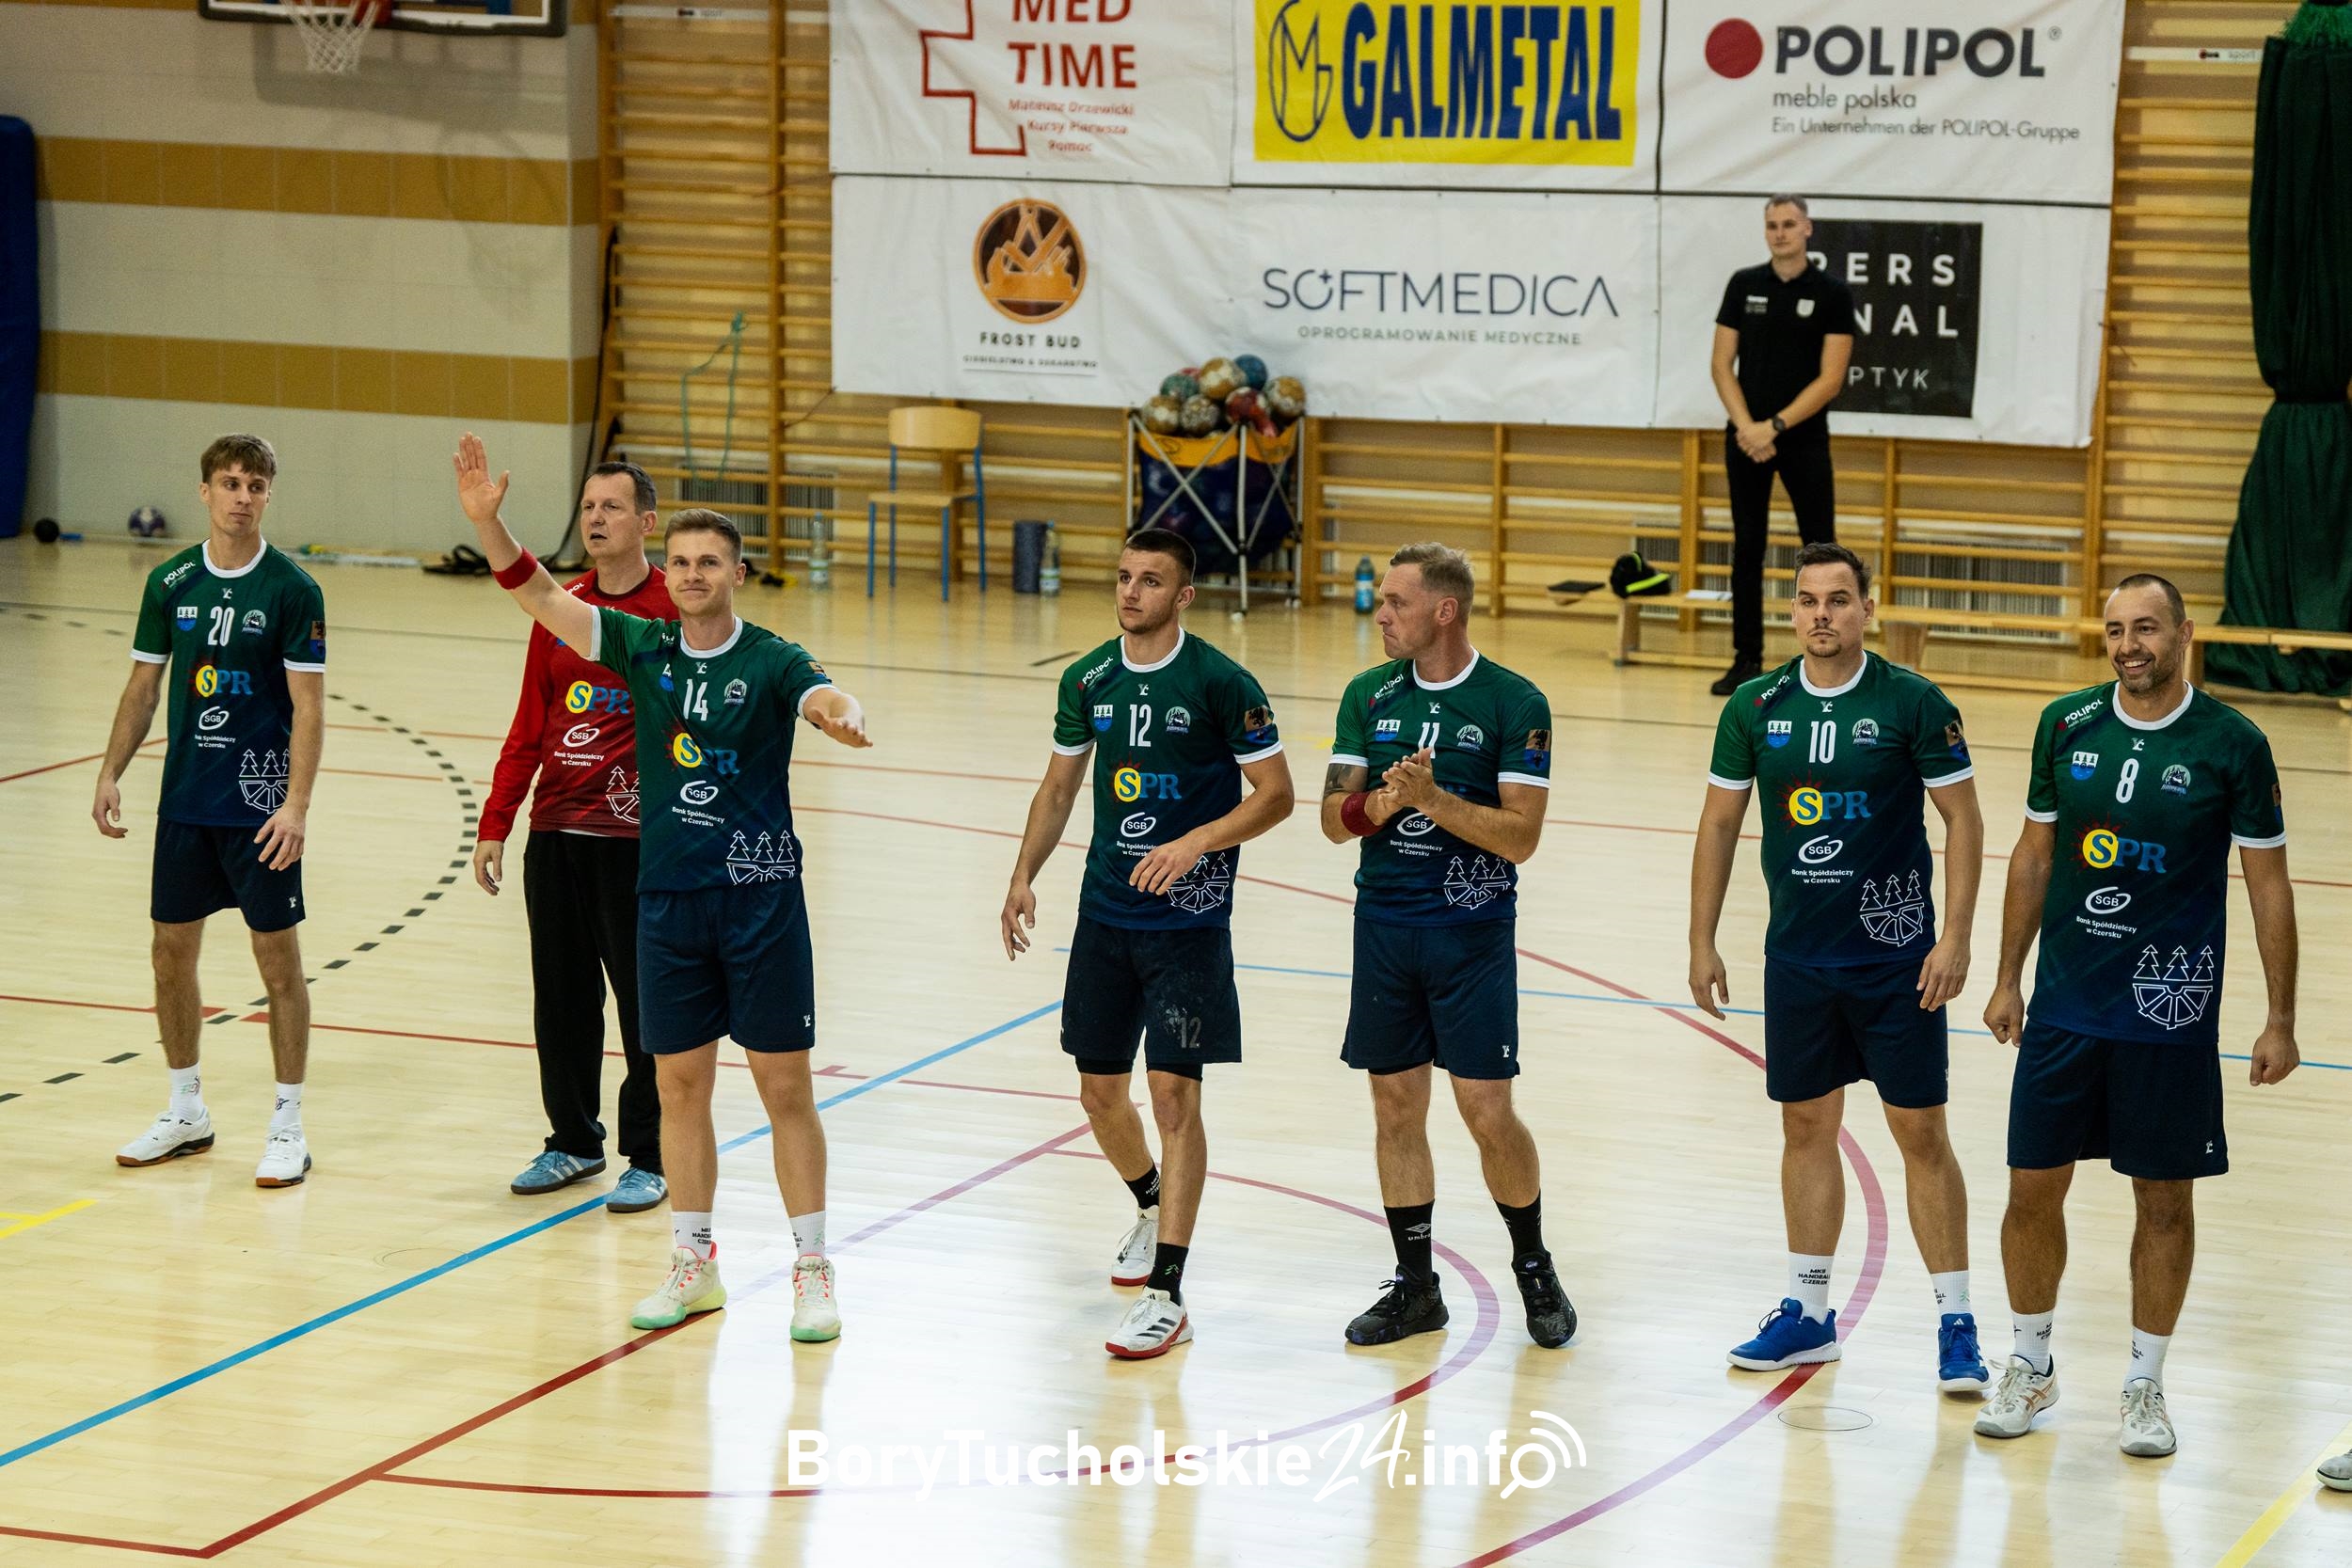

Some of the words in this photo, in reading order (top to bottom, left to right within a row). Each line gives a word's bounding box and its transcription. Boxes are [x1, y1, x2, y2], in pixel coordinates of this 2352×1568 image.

[1012, 0, 1133, 23] MED
[1007, 41, 1137, 88] TIME
[1774, 24, 2045, 78] POLIPOL
[1342, 2, 1622, 140] GALMETAL
[1772, 83, 1837, 108] meble
[1845, 85, 1917, 115] polska
[1772, 117, 1795, 134] Ein
[1800, 118, 1905, 135] Unternehmen
[1909, 117, 1936, 135] der
[1262, 267, 1619, 318] SOFTMEDICA
[1853, 302, 1959, 339] NAL
[979, 331, 1036, 346] FROST
[1046, 335, 1081, 348] BUD
[1297, 325, 1479, 343] OPROGRAMOWANIE
[1485, 331, 1582, 346] MEDYCZNE
[1848, 365, 1931, 390] PTYK
[163, 562, 197, 585] POLIPOL
[207, 606, 235, 647] 20
[200, 669, 254, 695] SPR
[1082, 657, 1114, 685] POLIPOL
[569, 683, 630, 715] SPR
[682, 678, 708, 721] 14
[2064, 698, 2104, 724] POLIPOL
[571, 731, 589, 740] SGB
[1129, 704, 1152, 748] 12
[1418, 721, 1440, 759] 11
[1808, 721, 1837, 764] 10
[680, 737, 740, 776] SPR
[1119, 771, 1182, 800] SPR
[2116, 757, 2140, 804] 8
[672, 806, 687, 816] Bank
[1796, 789, 1872, 821] SPR
[1126, 820, 1147, 830] SGB
[1406, 819, 1427, 830] SGB
[1403, 841, 1443, 852] Spółdzielczy
[1404, 848, 1430, 857] Czersku
[1808, 846, 1832, 855] SGB
[2089, 833, 2167, 874] SPR
[1808, 869, 1853, 878] Spółdzielczy
[2095, 895, 2119, 907] SGB
[2075, 915, 2091, 926] Bank
[2091, 920, 2137, 934] Spółdzielczy
[2092, 928, 2122, 939] Czersku
[1180, 1017, 1202, 1049] 12
